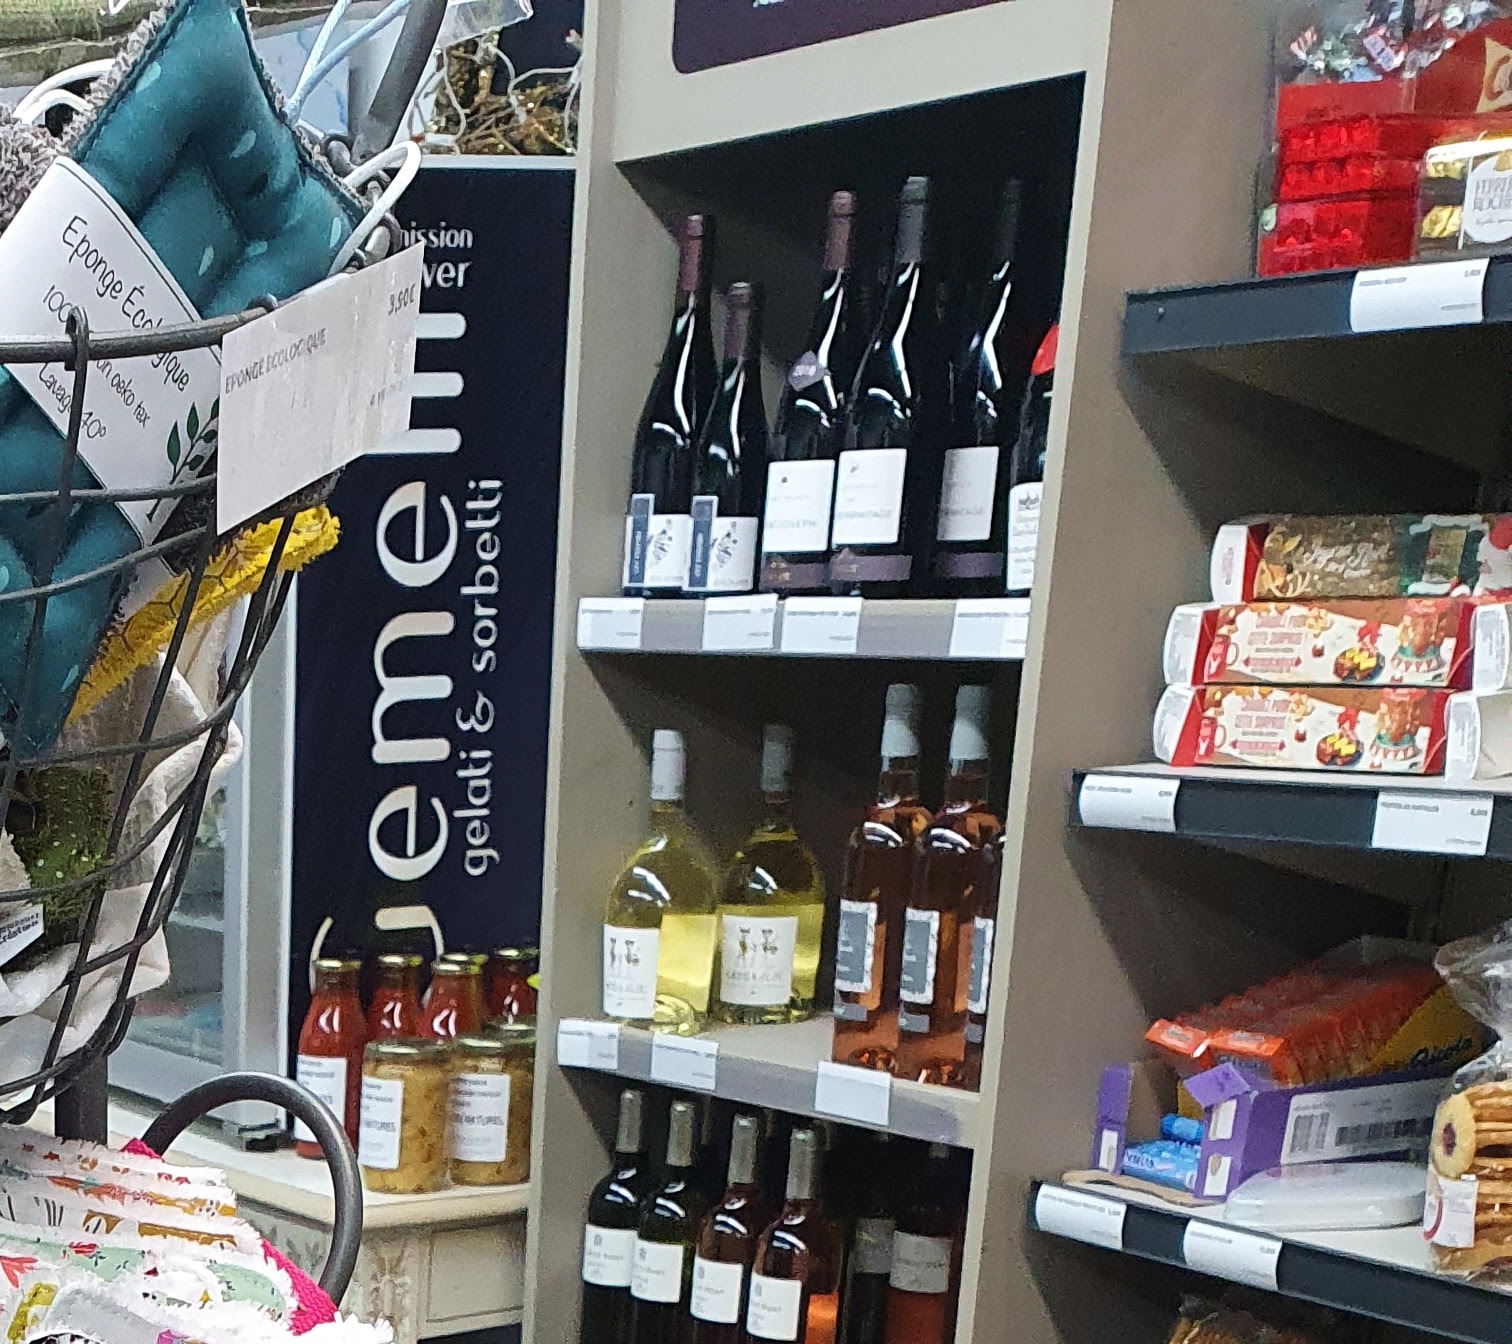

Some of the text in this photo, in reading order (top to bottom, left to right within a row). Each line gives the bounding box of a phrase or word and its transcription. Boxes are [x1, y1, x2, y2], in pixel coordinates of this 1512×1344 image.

[63, 216, 190, 391] Eponge Écolgique
[454, 479, 503, 877] gelati & sorbetti
